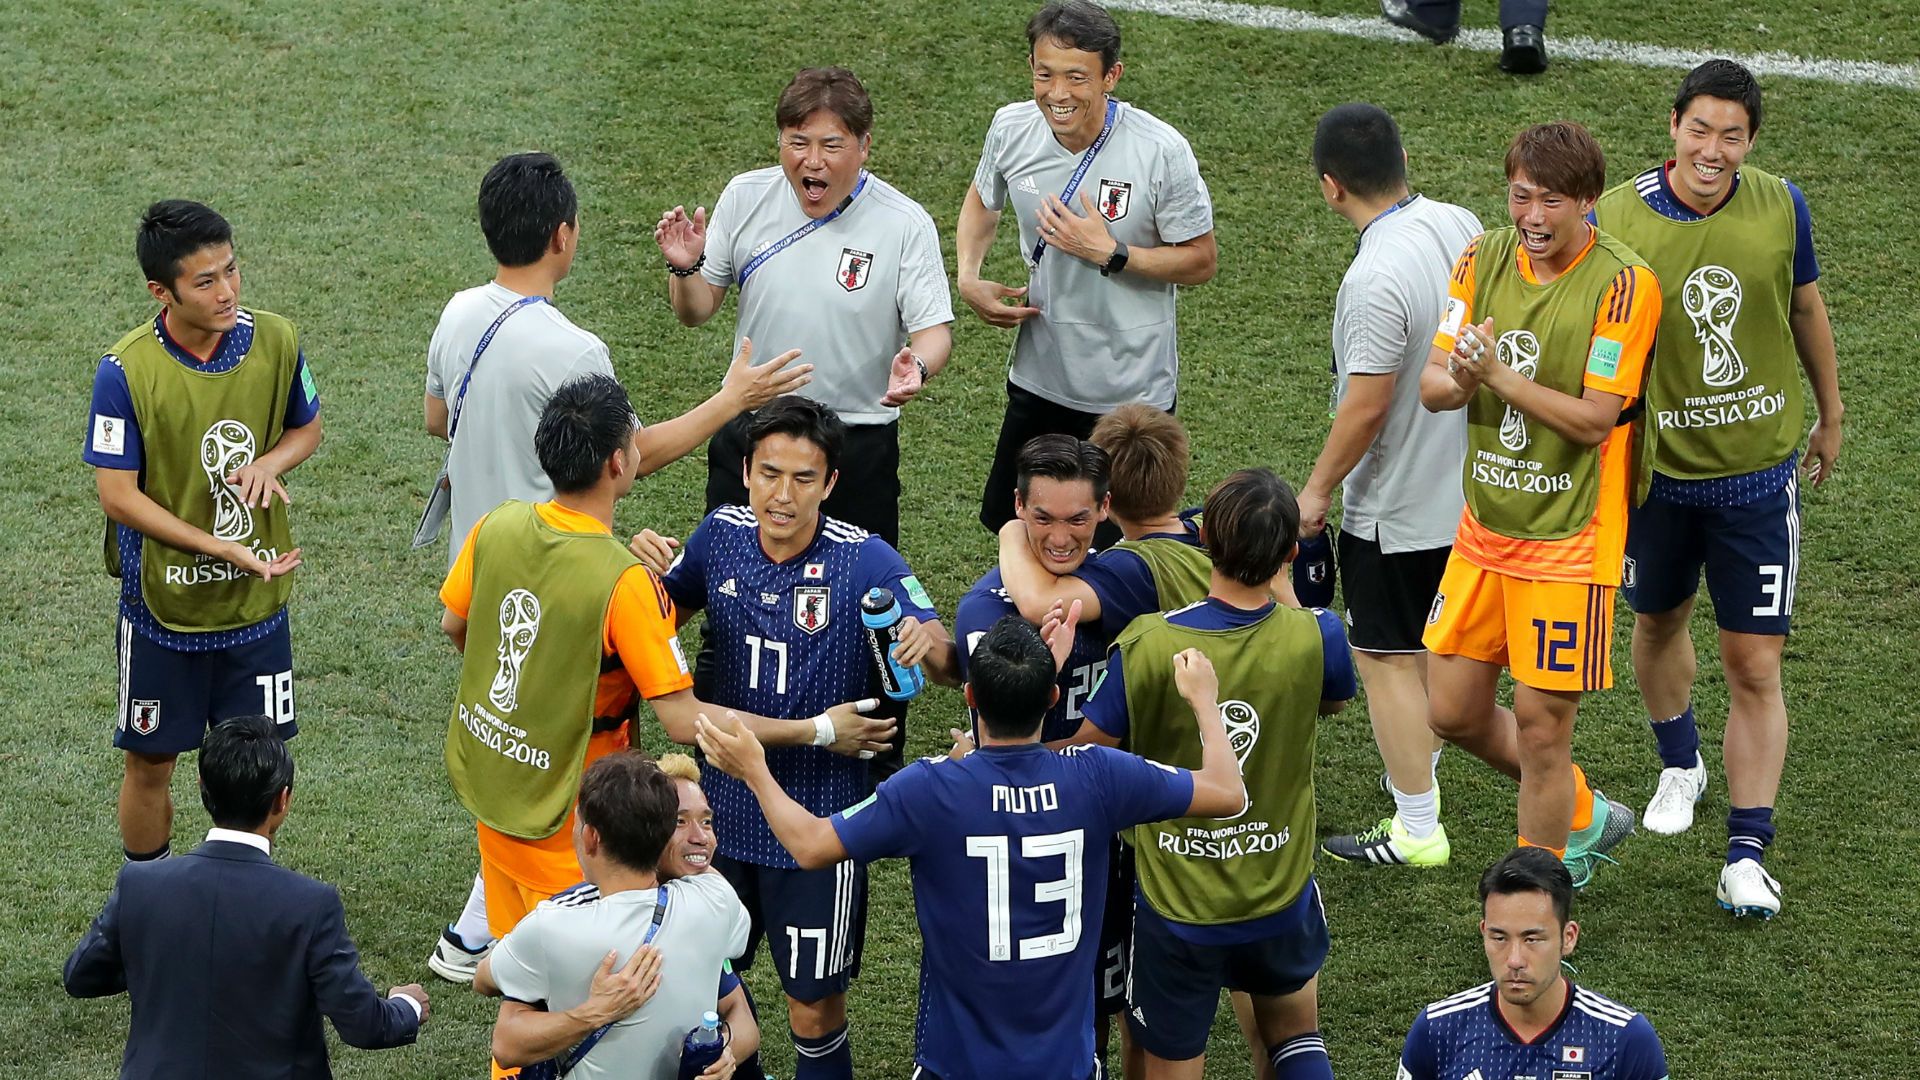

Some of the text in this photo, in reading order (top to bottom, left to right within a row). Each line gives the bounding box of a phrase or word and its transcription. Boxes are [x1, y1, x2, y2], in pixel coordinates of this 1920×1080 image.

[1074, 160, 1089, 182] WORLD
[1086, 148, 1097, 161] CUP
[1093, 126, 1110, 149] RUSSIA
[1017, 183, 1039, 195] adidas
[792, 223, 815, 241] RUSSIA
[1685, 384, 1765, 407] FIFA WORLD CUP
[1657, 403, 1745, 430] RUSSIA
[1477, 449, 1543, 472] FIFA WORLD CUP
[1521, 472, 1573, 494] 2018
[1752, 564, 1784, 617] 3
[867, 628, 893, 692] POWERADE
[1532, 618, 1579, 672] 12
[745, 634, 787, 695] 17
[256, 669, 295, 725] 18
[459, 703, 550, 770] RUSSIA 2018
[474, 703, 527, 739] FIFA WORLD CUP
[992, 783, 1058, 814] MUTO
[1158, 831, 1244, 860] RUSSIA
[1187, 821, 1269, 840] FIFA WORLD CUP
[966, 828, 1084, 961] 13
[786, 925, 827, 980] 17
